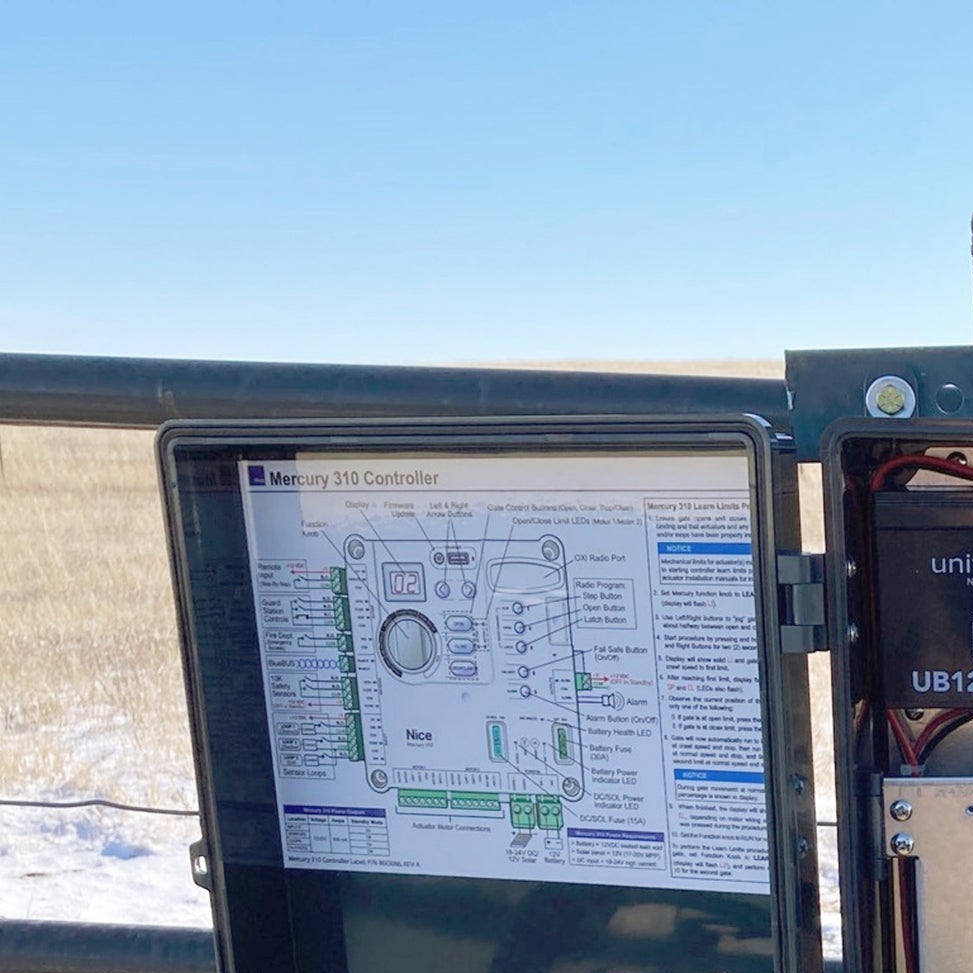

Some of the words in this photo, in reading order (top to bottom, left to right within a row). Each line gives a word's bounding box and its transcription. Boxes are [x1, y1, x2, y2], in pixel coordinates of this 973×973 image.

[270, 471, 329, 489] Mercury
[333, 470, 359, 486] 310
[363, 470, 440, 486] Controller
[589, 554, 609, 562] Radio
[611, 554, 626, 562] Port
[575, 581, 595, 589] Radio
[582, 592, 599, 601] Step
[600, 592, 622, 600] Button
[582, 604, 602, 613] Open
[603, 604, 626, 612] Button
[605, 616, 627, 624] Button
[625, 646, 648, 654] Button
[626, 697, 648, 706] Alarm
[585, 714, 605, 722] Alarm
[608, 715, 630, 723] Button
[406, 728, 433, 741] Nice
[588, 727, 611, 737] Battery
[613, 728, 635, 736] Health
[637, 729, 652, 737] LED
[589, 744, 613, 753] Battery
[616, 745, 632, 753] Fuse
[591, 767, 615, 777] Battery
[622, 776, 637, 784] LED
[623, 794, 644, 802] Power
[624, 802, 639, 810] LED
[609, 815, 625, 824] Fuse
